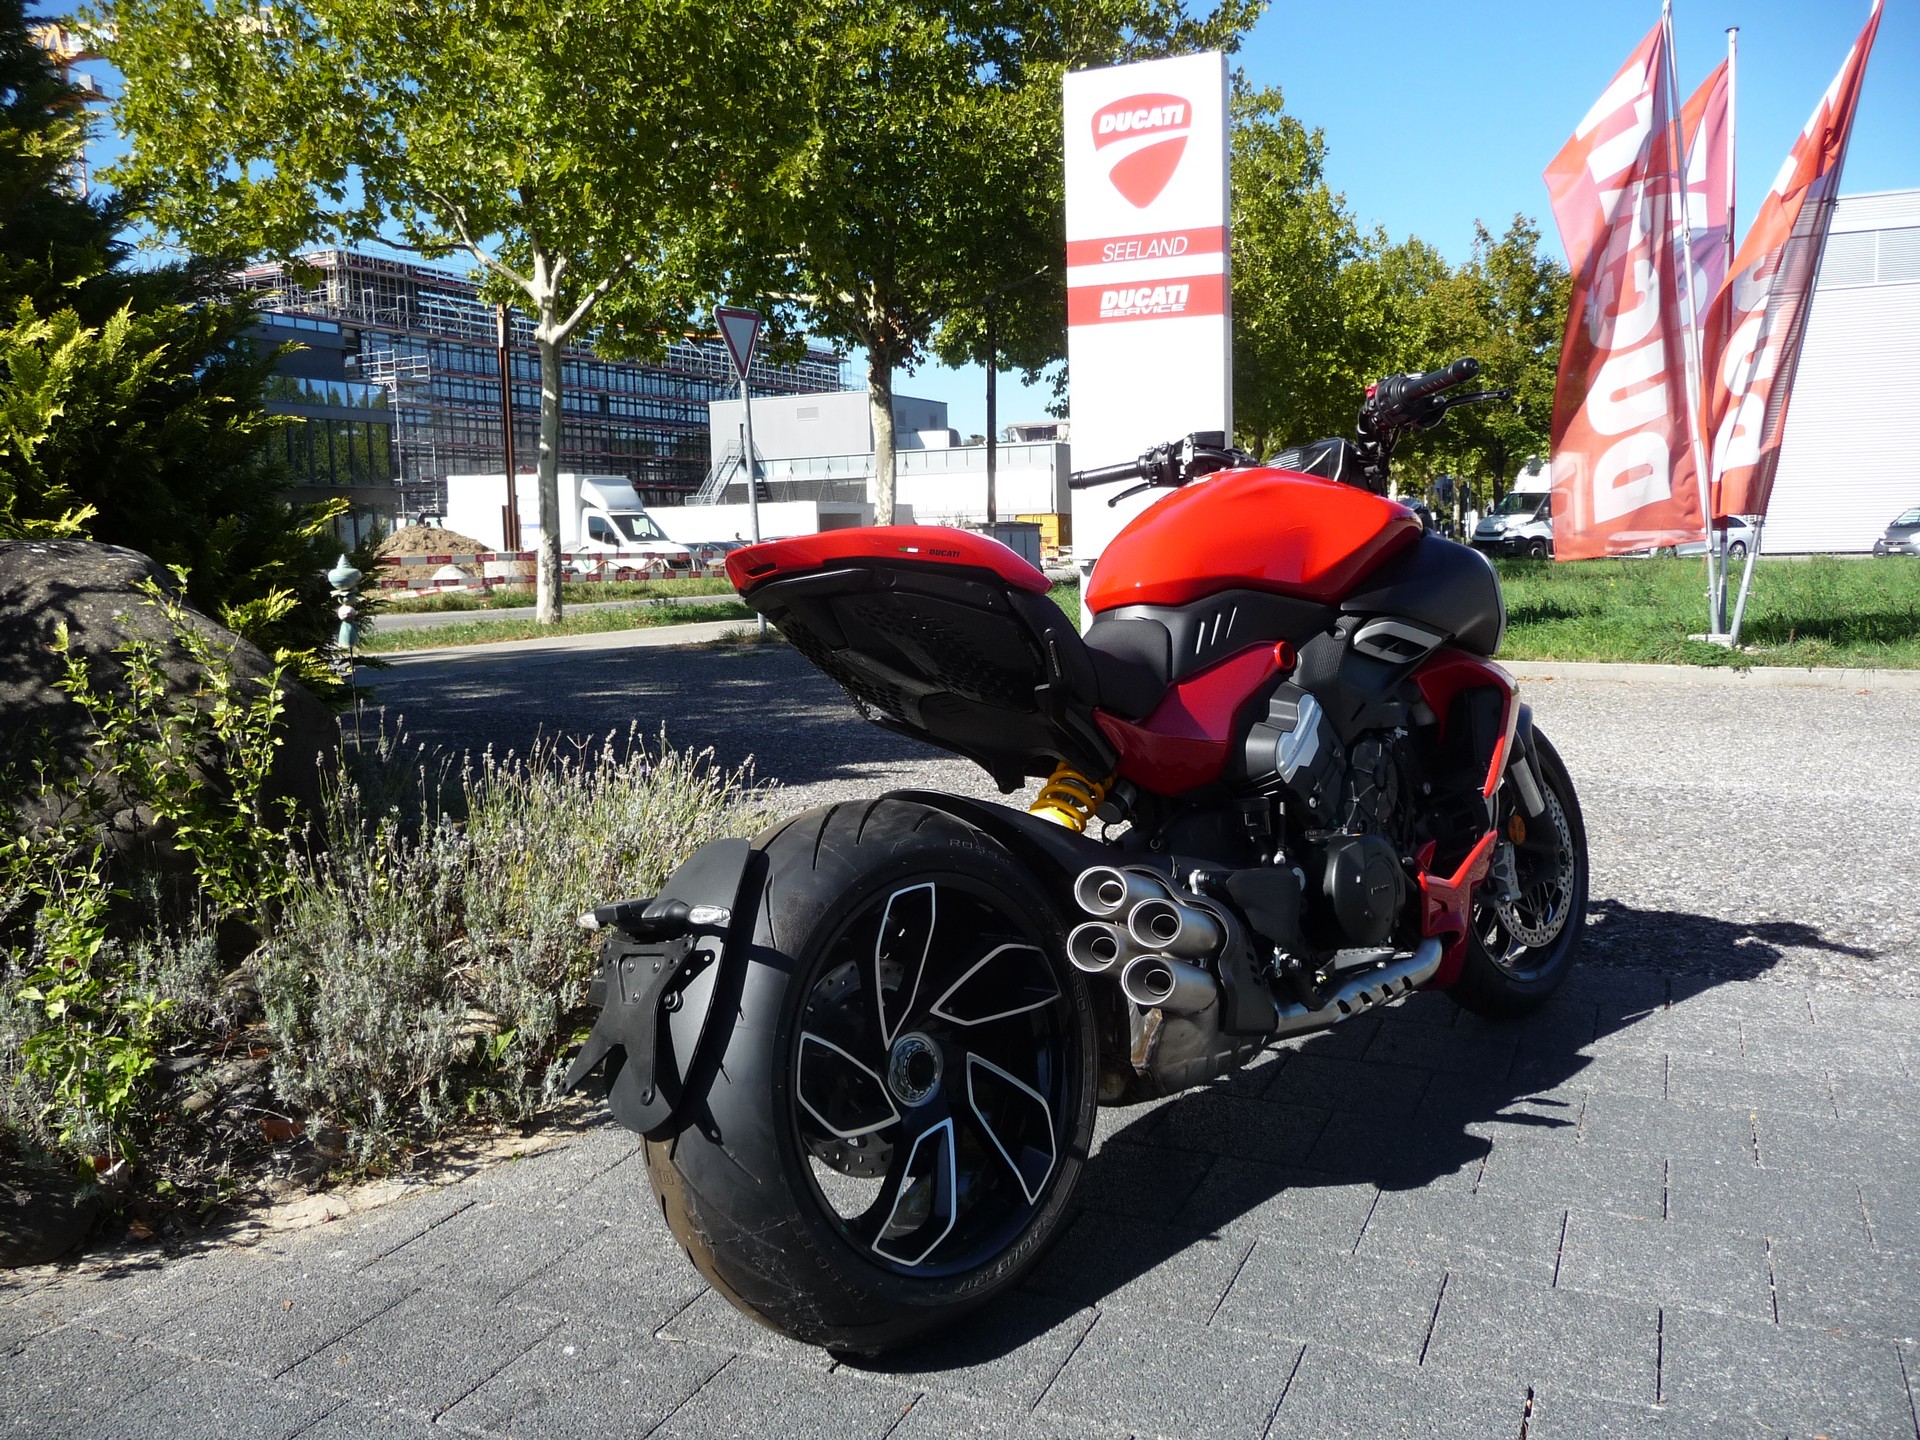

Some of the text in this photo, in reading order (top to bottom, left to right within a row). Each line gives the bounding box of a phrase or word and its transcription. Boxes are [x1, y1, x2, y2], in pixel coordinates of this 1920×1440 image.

[1098, 104, 1184, 135] DUCATI
[1102, 236, 1188, 263] SEELAND
[1100, 284, 1189, 310] DUCATI
[1099, 303, 1186, 318] SERVICE
[928, 548, 961, 558] DUCATI
